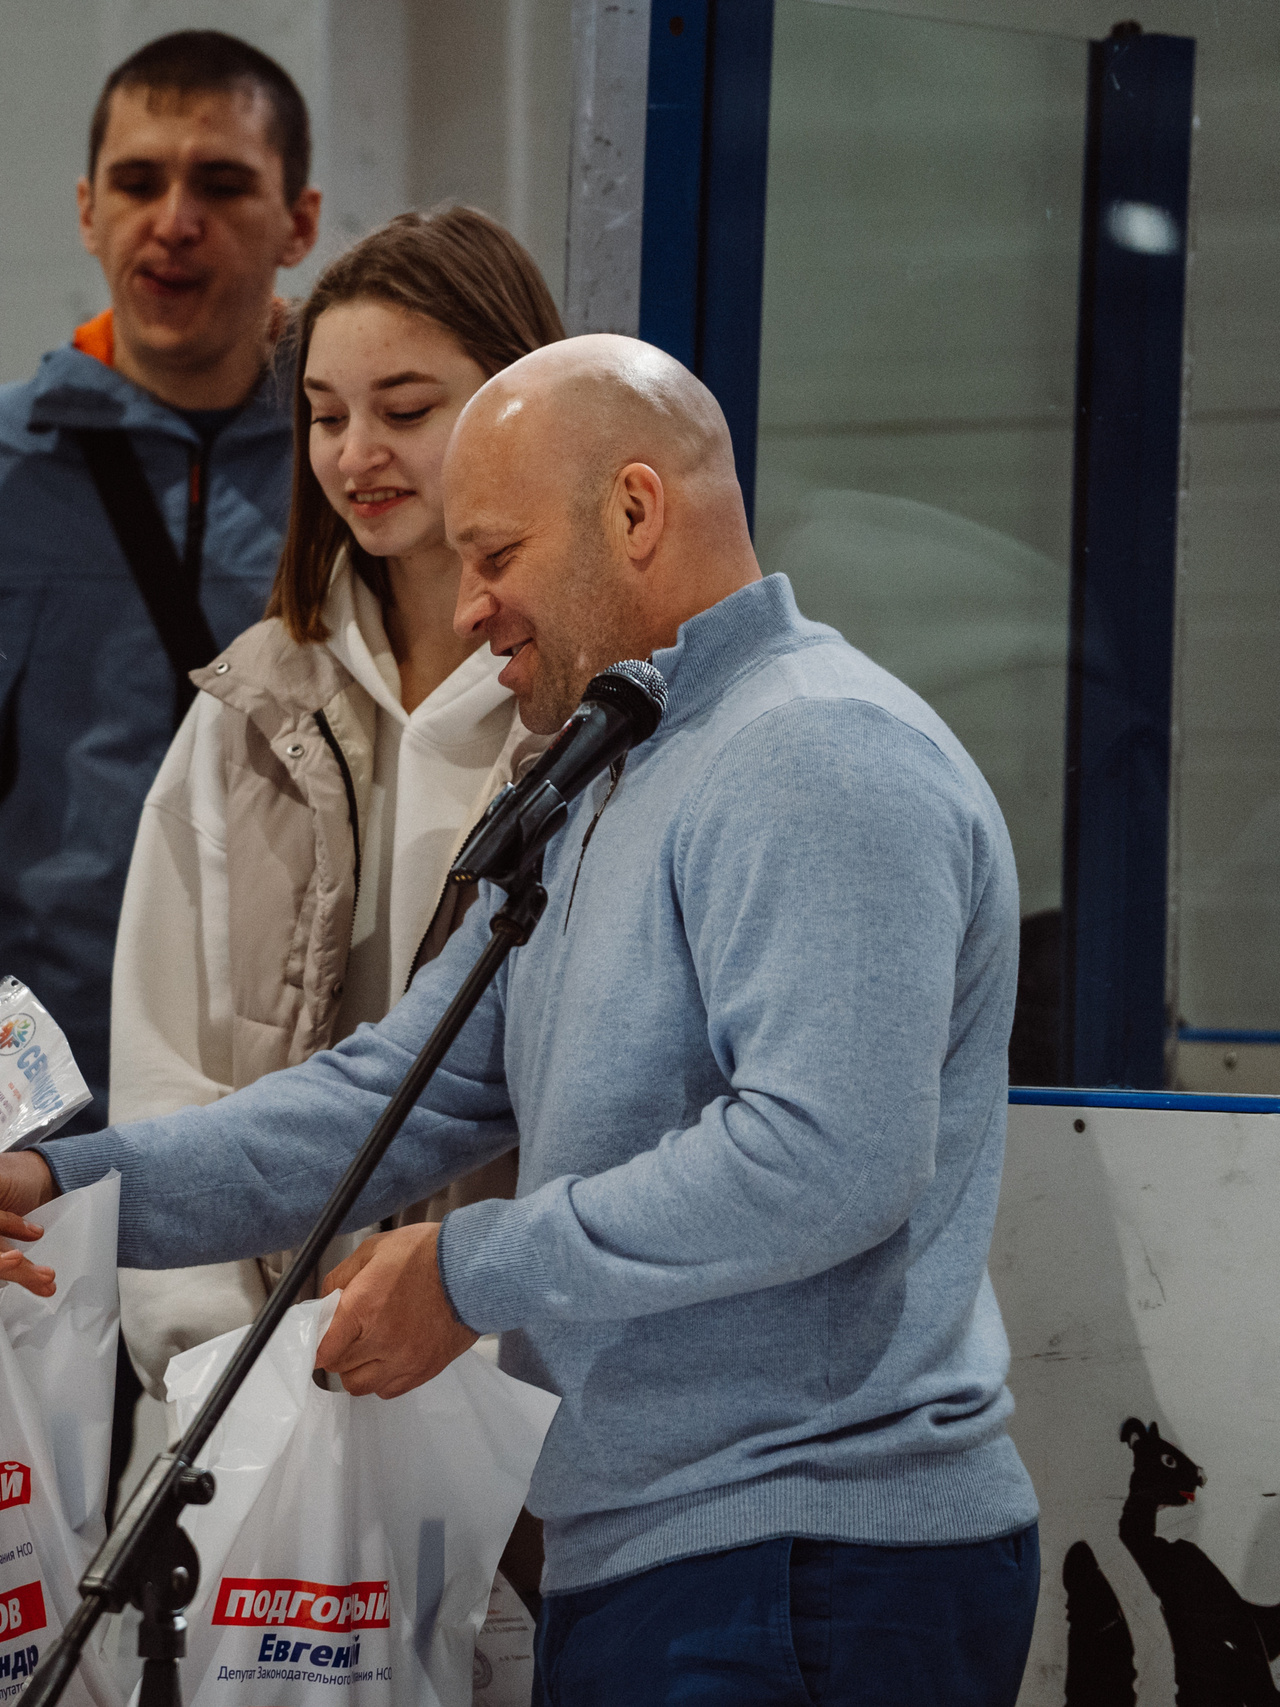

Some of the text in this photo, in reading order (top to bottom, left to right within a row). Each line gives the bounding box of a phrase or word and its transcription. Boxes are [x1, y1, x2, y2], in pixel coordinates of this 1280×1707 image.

[17, 1542, 33, 1558] НСО
[218, 1666, 256, 1681] Депутат
[257, 1666, 351, 1685] Законодательного
[376, 1667, 392, 1681] НСО
